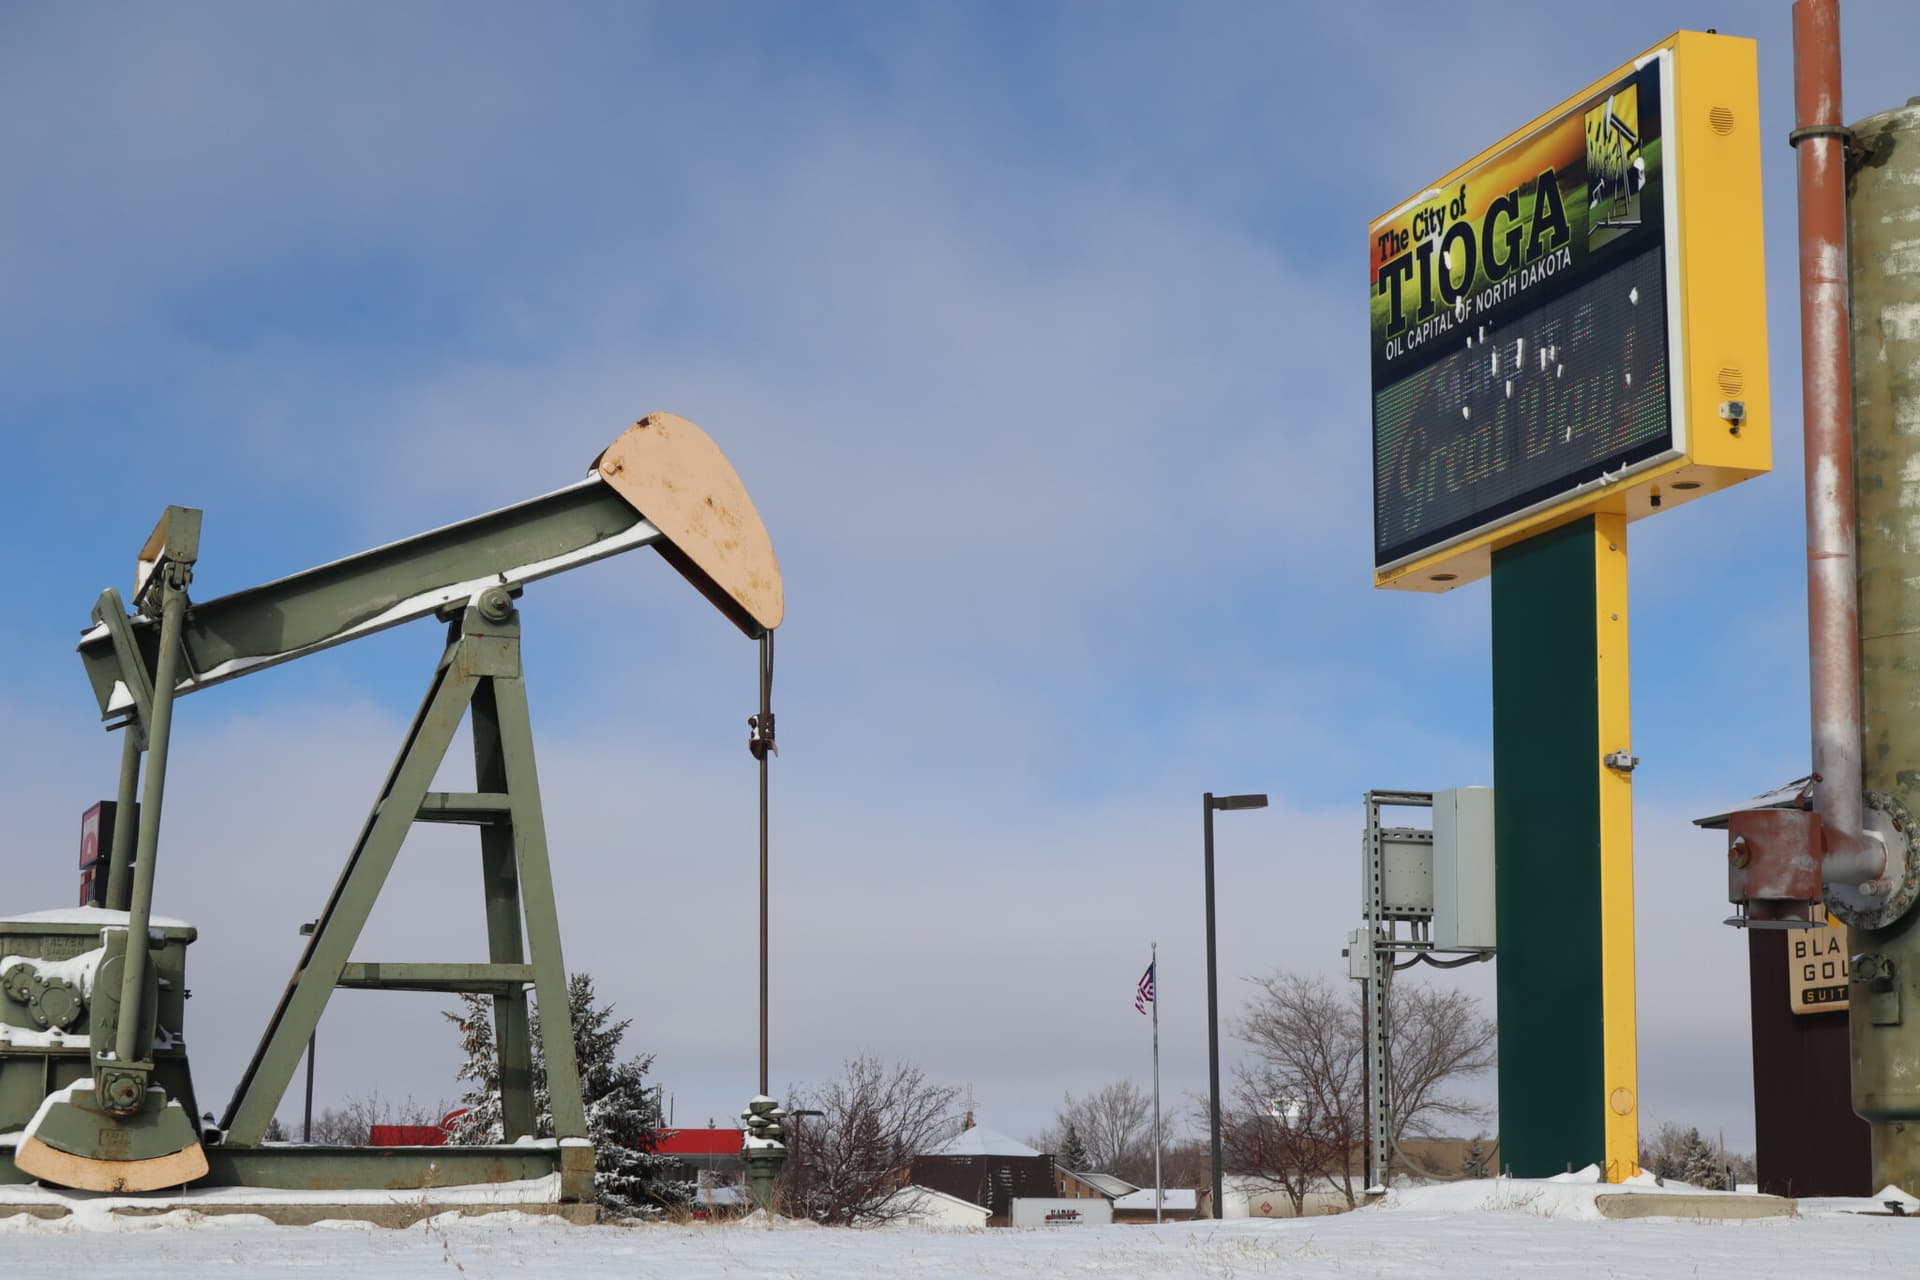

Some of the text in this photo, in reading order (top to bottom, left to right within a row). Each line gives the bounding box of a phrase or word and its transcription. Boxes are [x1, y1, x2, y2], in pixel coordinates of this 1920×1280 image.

[1378, 185, 1467, 262] The City of
[1378, 167, 1570, 339] TIOGA
[1386, 246, 1571, 361] OIL CAPITAL OF NORTH DAKOTA
[1795, 937, 1840, 958] BLA
[1803, 960, 1848, 981] GOL
[1807, 988, 1845, 1001] SUIT
